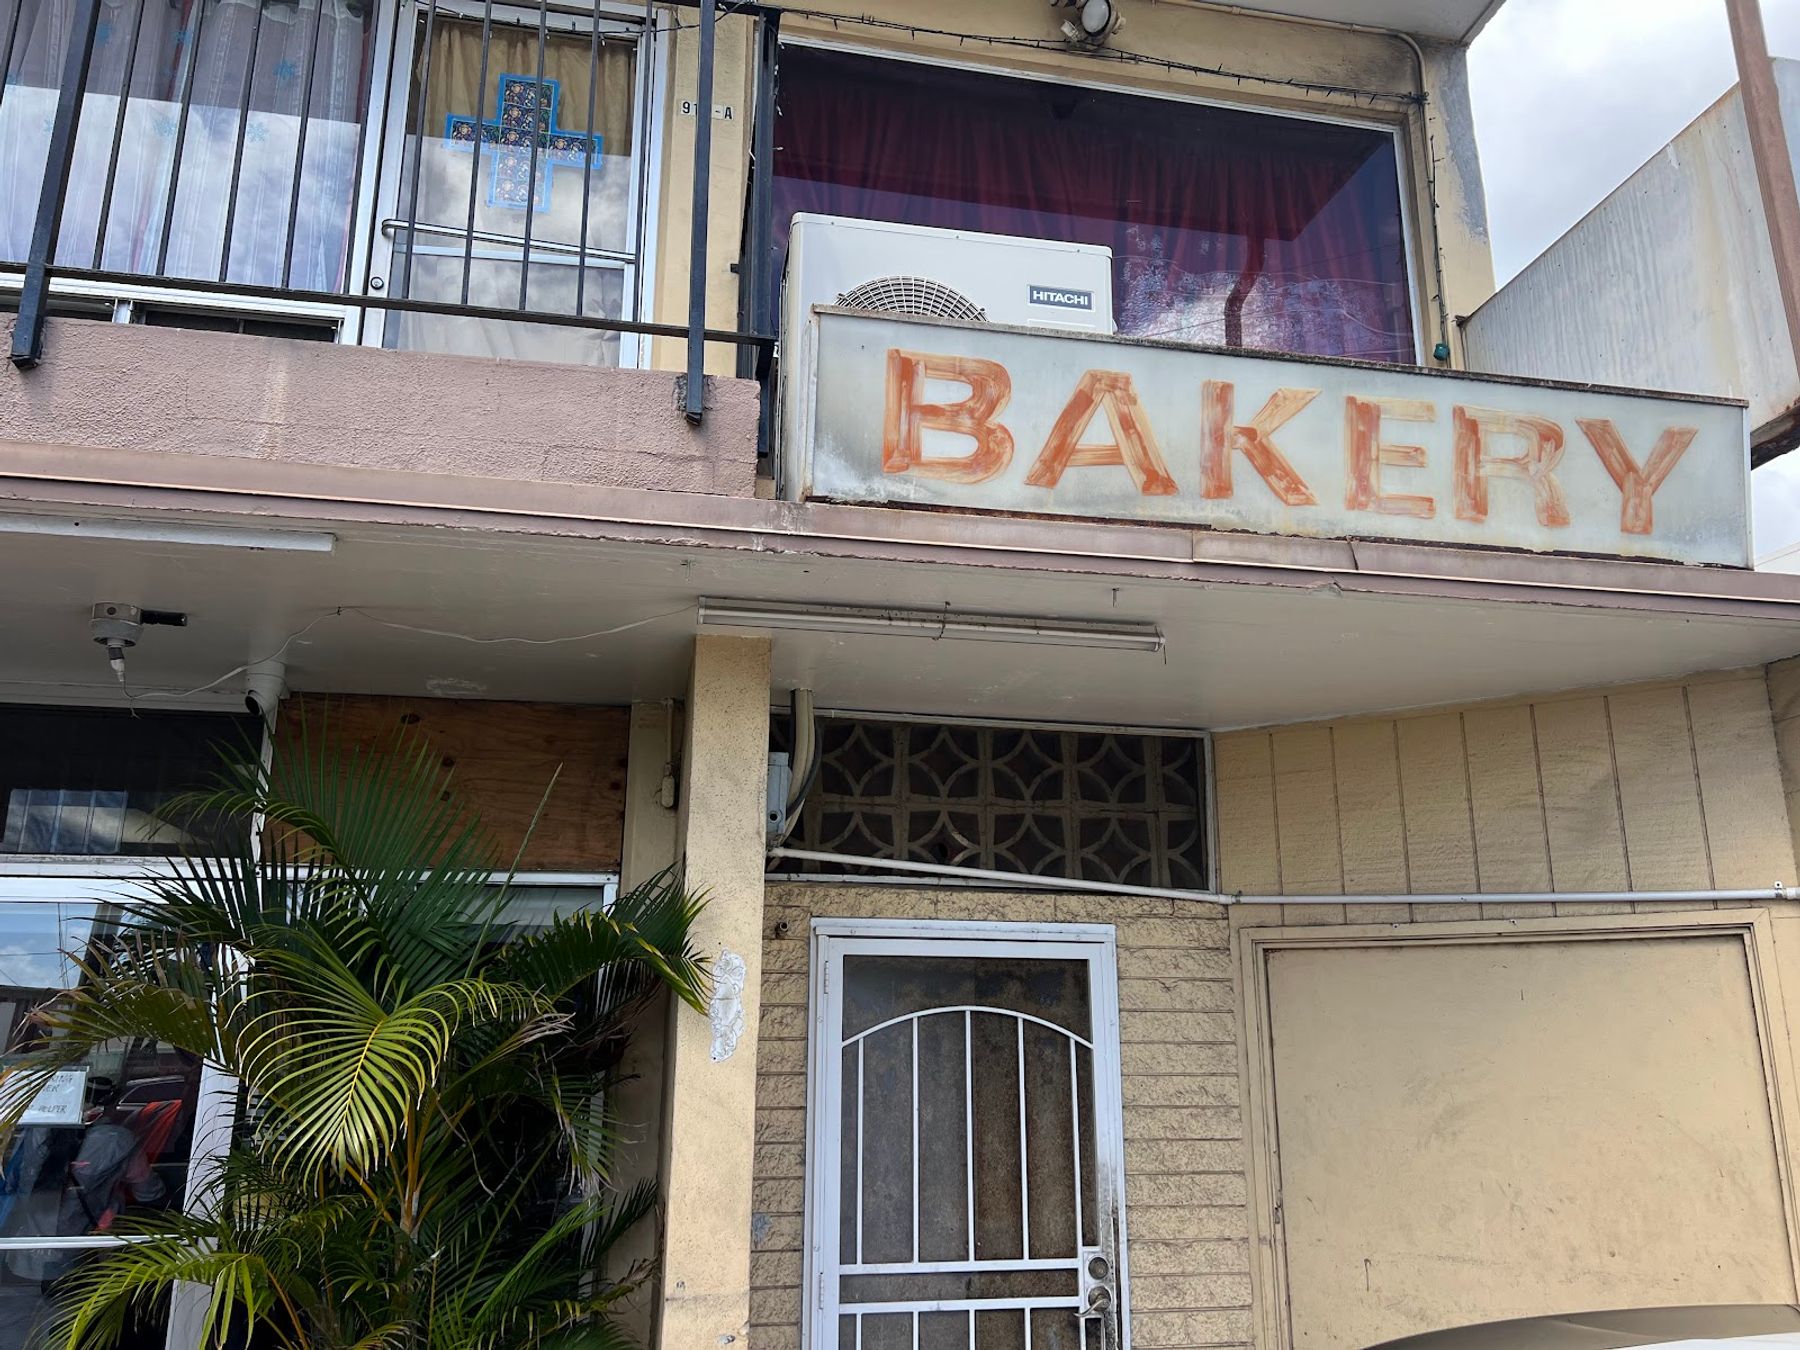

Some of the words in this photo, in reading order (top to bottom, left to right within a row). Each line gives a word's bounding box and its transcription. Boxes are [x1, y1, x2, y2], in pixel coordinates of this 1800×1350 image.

[682, 101, 733, 120] 91-A
[1032, 290, 1089, 306] HITACHI
[883, 348, 1698, 535] BAKERY
